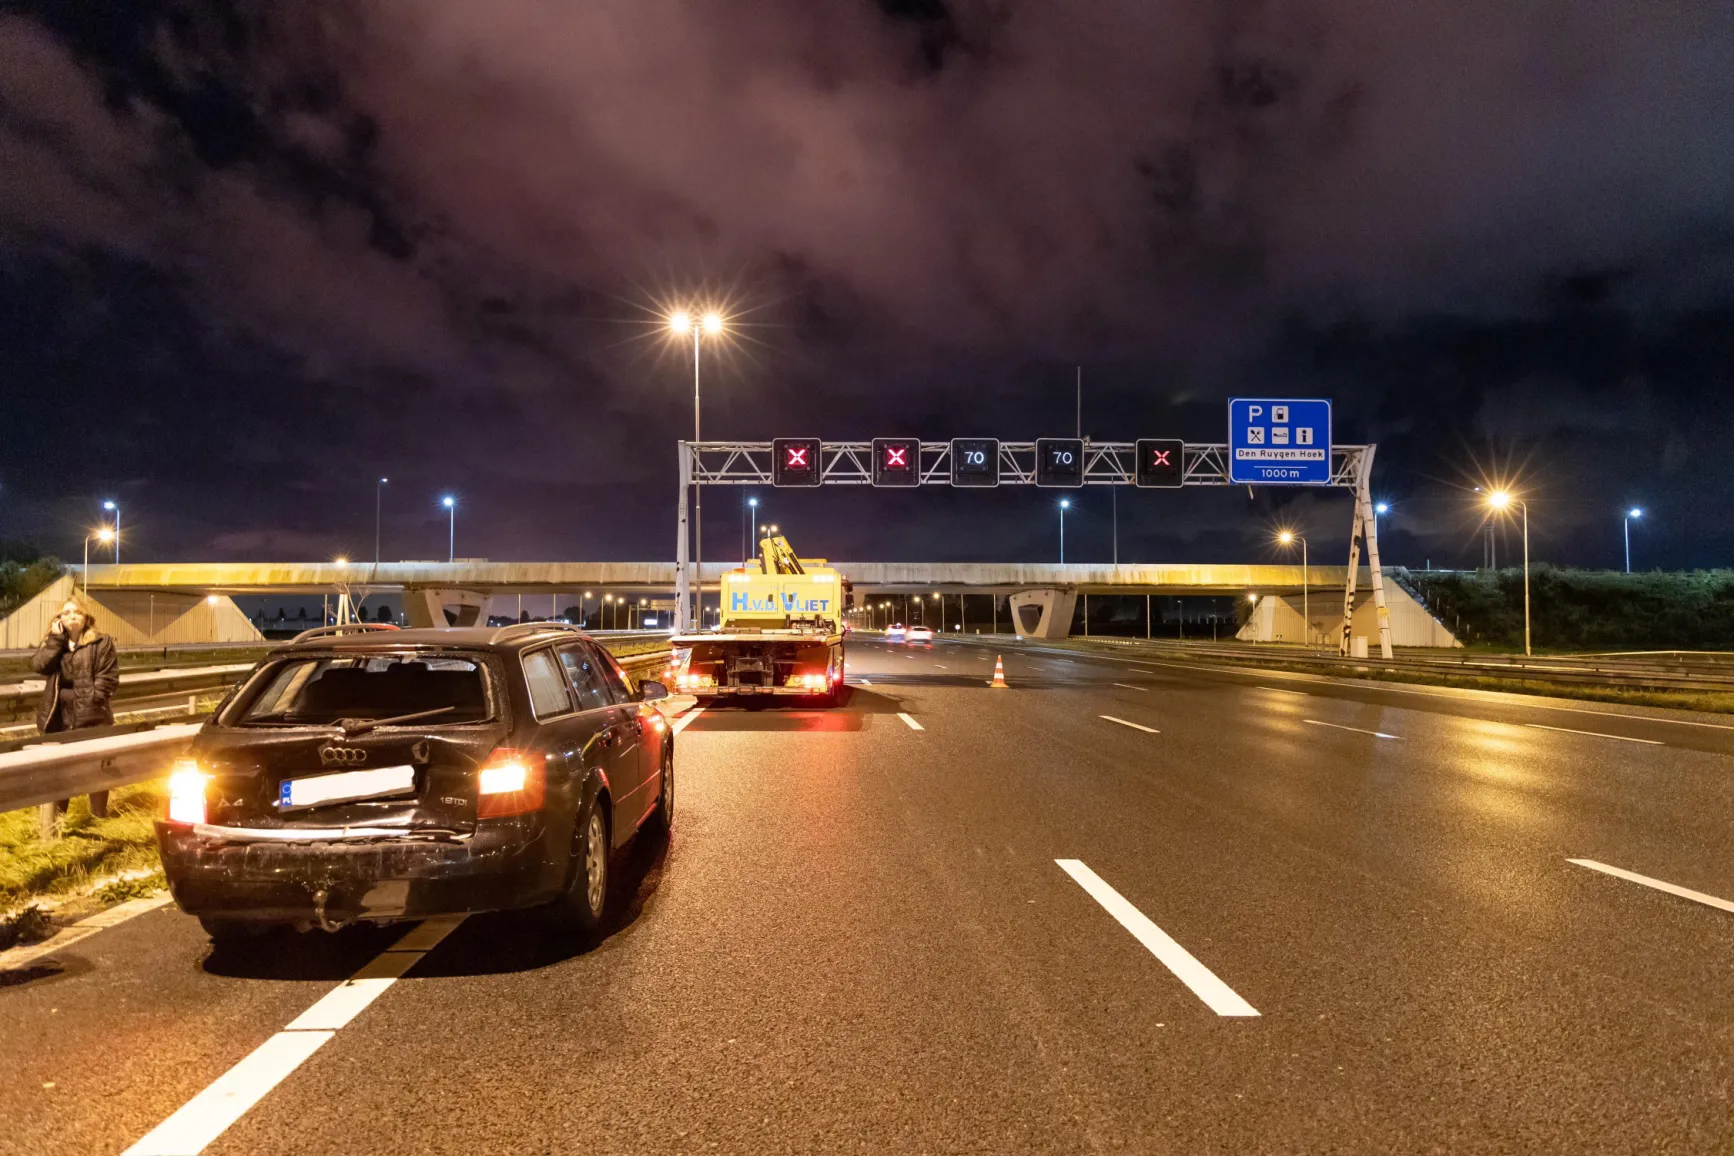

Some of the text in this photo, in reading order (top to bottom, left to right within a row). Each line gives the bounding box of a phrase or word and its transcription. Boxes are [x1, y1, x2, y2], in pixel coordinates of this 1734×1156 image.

[1249, 405, 1263, 423] P
[964, 451, 985, 464] 70
[1052, 451, 1073, 464] 70
[1260, 450, 1296, 459] Ruygen
[1300, 450, 1323, 458] Hoek
[1262, 469, 1300, 478] 1000 m
[217, 798, 244, 808] A4
